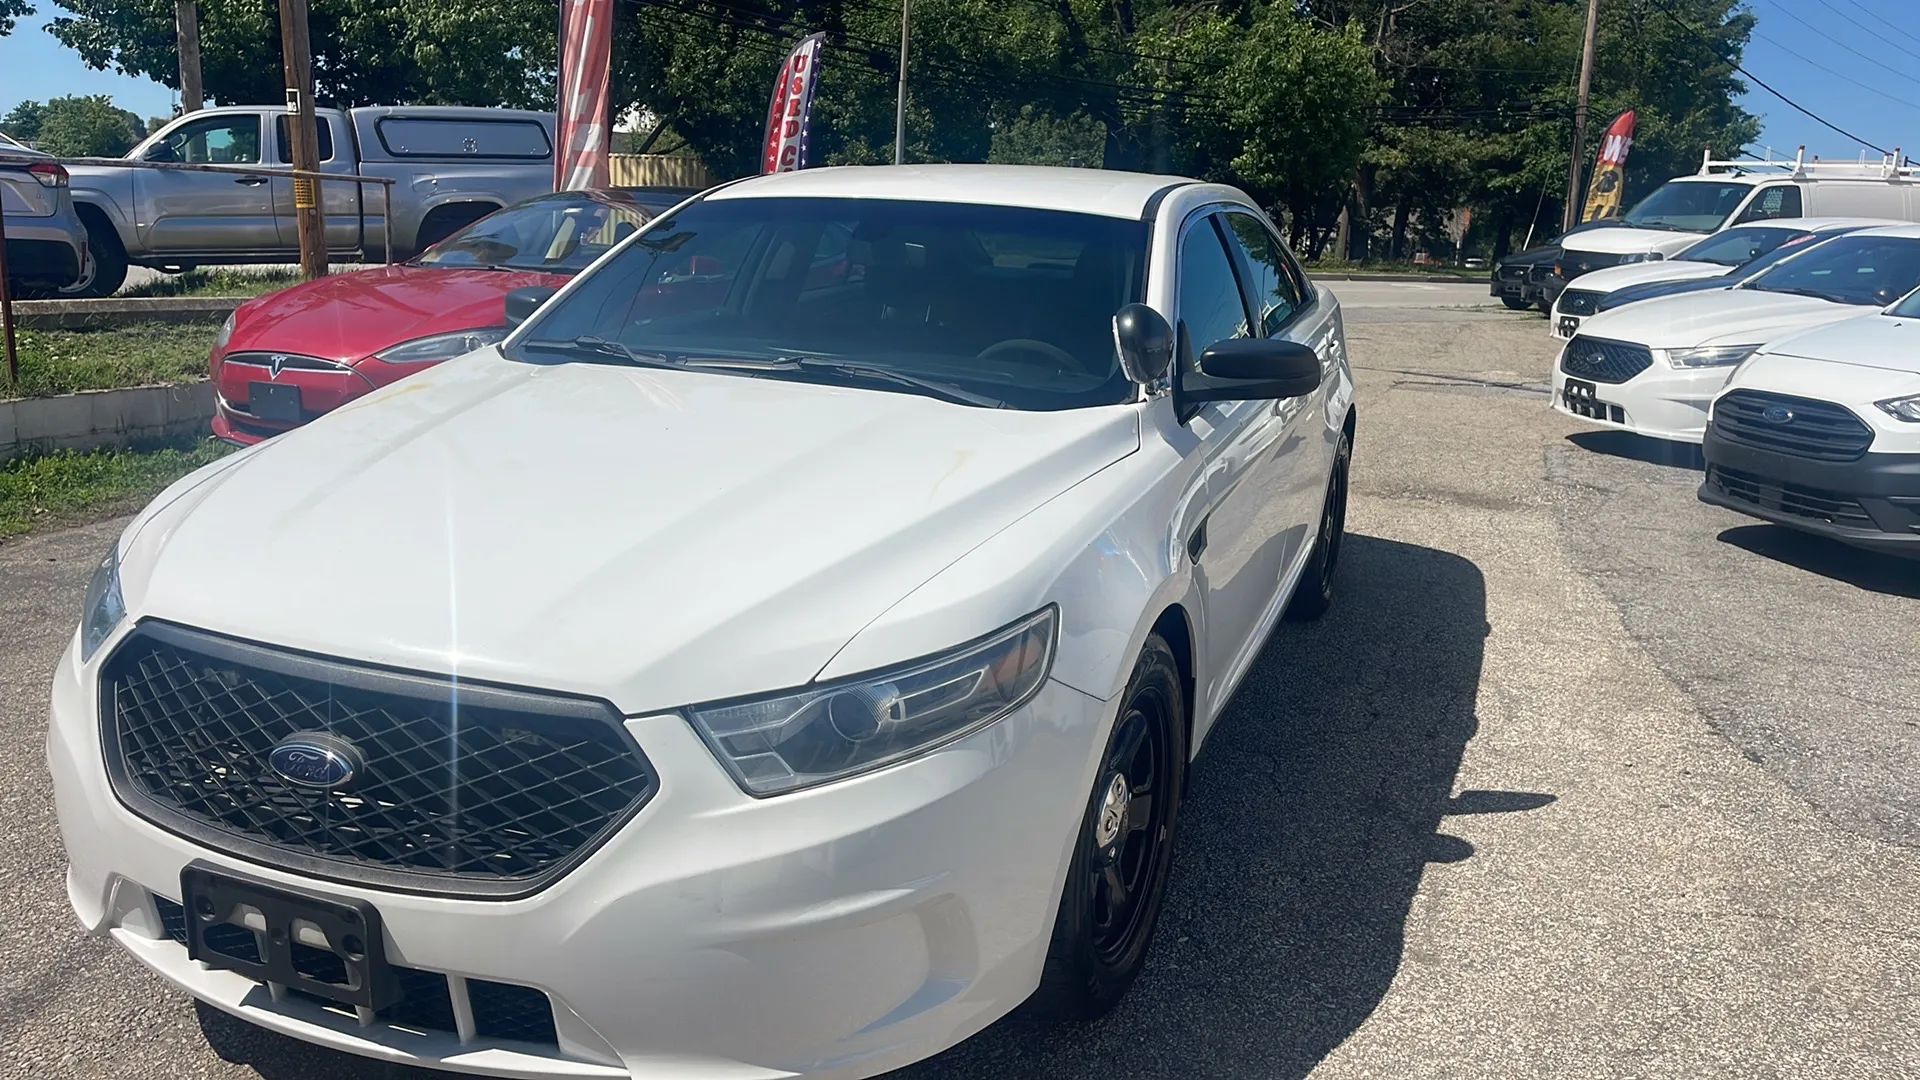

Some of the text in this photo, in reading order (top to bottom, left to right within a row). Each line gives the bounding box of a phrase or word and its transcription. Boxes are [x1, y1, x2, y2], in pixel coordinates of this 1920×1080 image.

[780, 54, 808, 173] USED C
[284, 751, 330, 777] Ford
